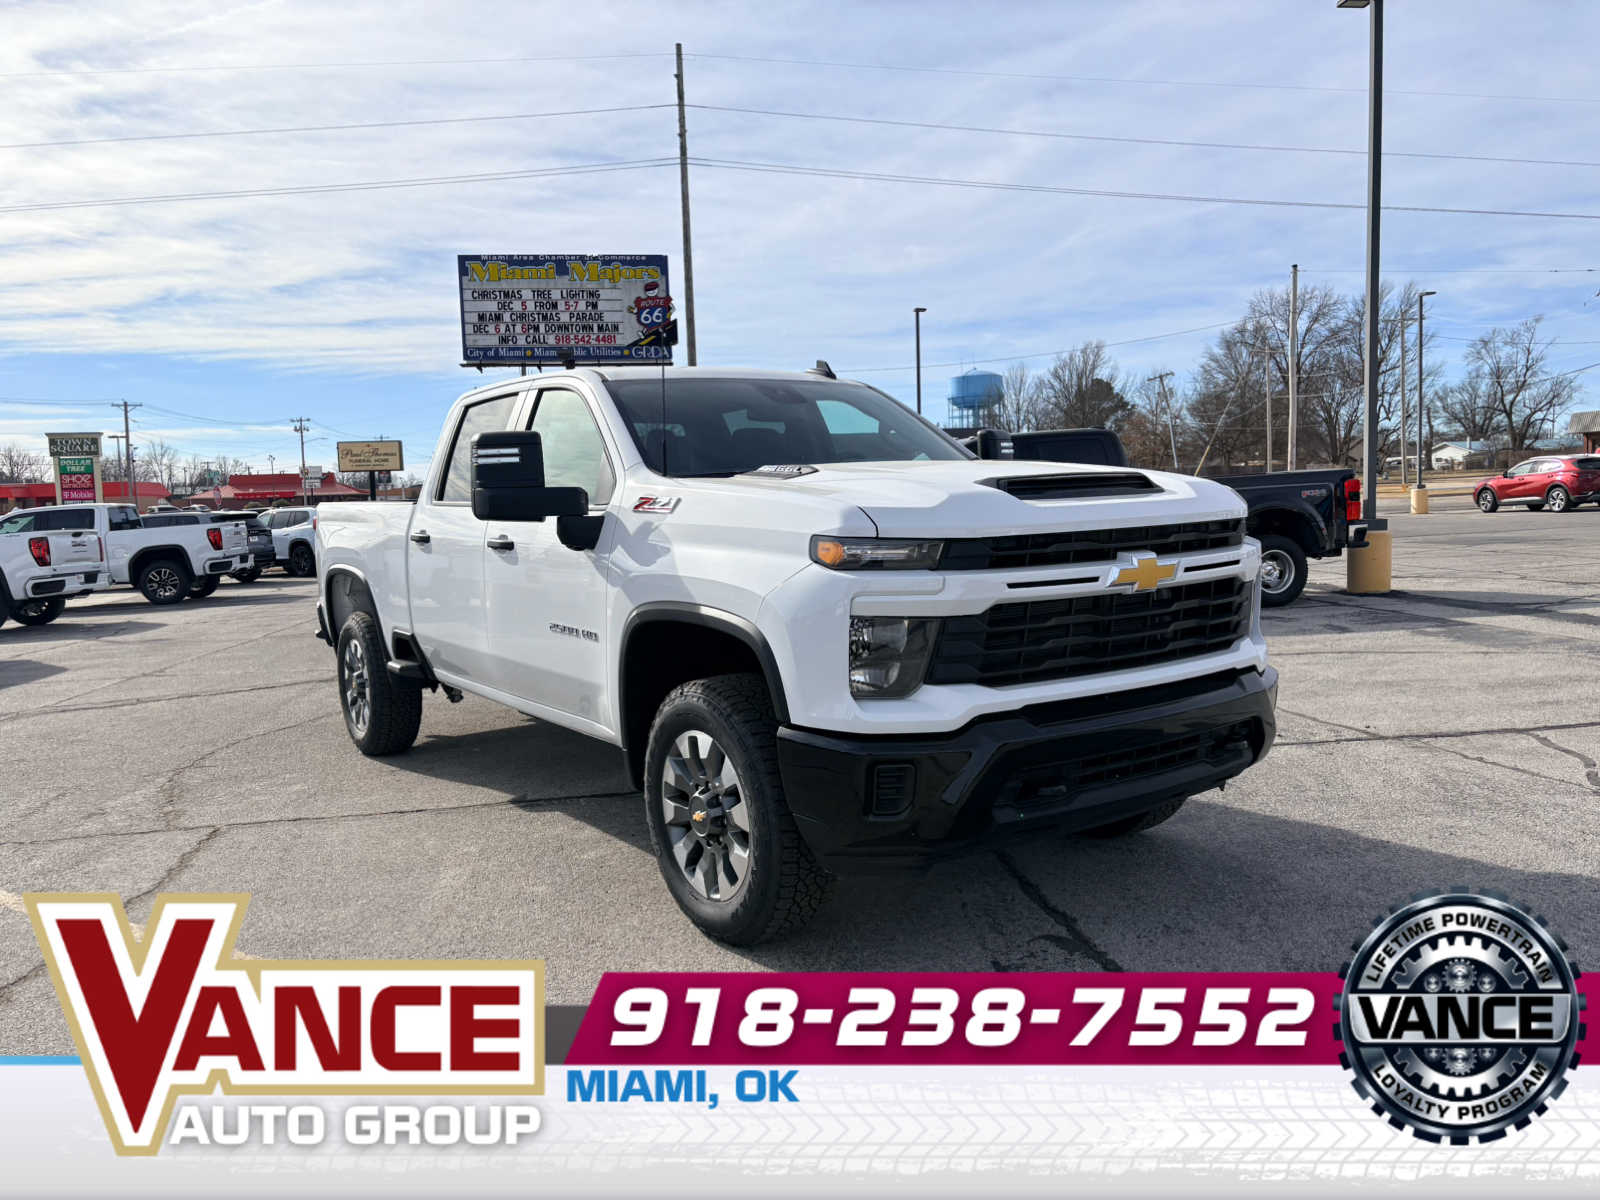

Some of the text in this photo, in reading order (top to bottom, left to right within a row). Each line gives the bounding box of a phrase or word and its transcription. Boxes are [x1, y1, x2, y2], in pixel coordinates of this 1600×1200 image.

[467, 262, 660, 284] Miami Majors
[471, 289, 600, 300] CHRISTMAS TREE LIGHTING
[497, 301, 598, 311] DEC 5 FROM 5-7 PM
[640, 299, 665, 307] ROUTE
[477, 312, 604, 322] MIAMI CHRISTMAS PARADE
[640, 307, 663, 324] 66
[472, 322, 619, 334] DEC 6 AT 6PM DOWNTOWN MAIN
[498, 335, 617, 345] INFO CALL 918-542-4481
[467, 348, 524, 359] City of Miami
[534, 347, 558, 357] Miam
[590, 346, 621, 356] Utilities
[631, 345, 670, 358] GRDA
[50, 445, 97, 453] SQUARE
[633, 496, 682, 514] Z71
